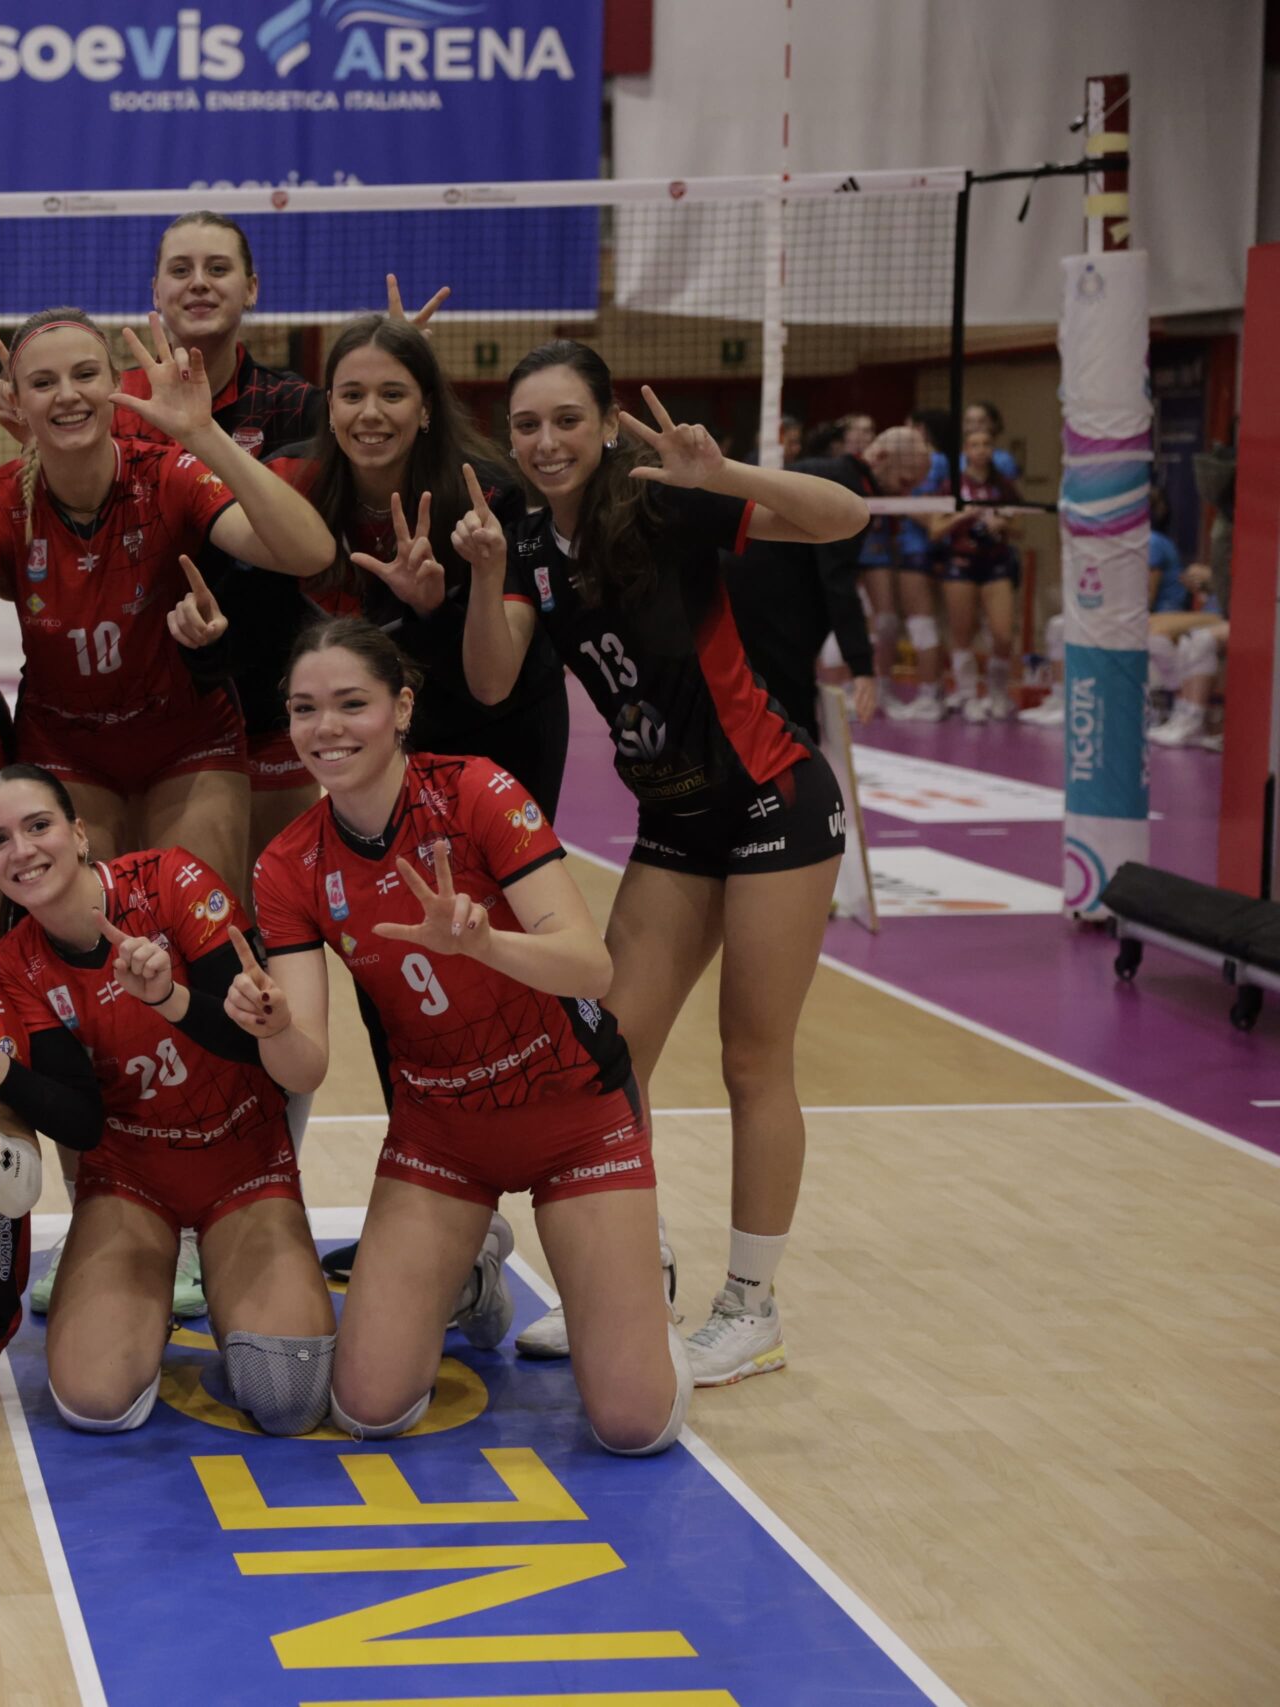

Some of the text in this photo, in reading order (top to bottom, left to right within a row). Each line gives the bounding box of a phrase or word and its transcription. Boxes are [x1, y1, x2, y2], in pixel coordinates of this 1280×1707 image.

[333, 26, 575, 81] ARENA
[205, 89, 339, 111] ENERGETICA
[343, 89, 442, 111] ITALIANA
[67, 620, 122, 677] 10
[579, 632, 638, 694] 13
[400, 952, 450, 1017] 9
[125, 1037, 188, 1100] 28
[105, 1115, 182, 1140] Quanta
